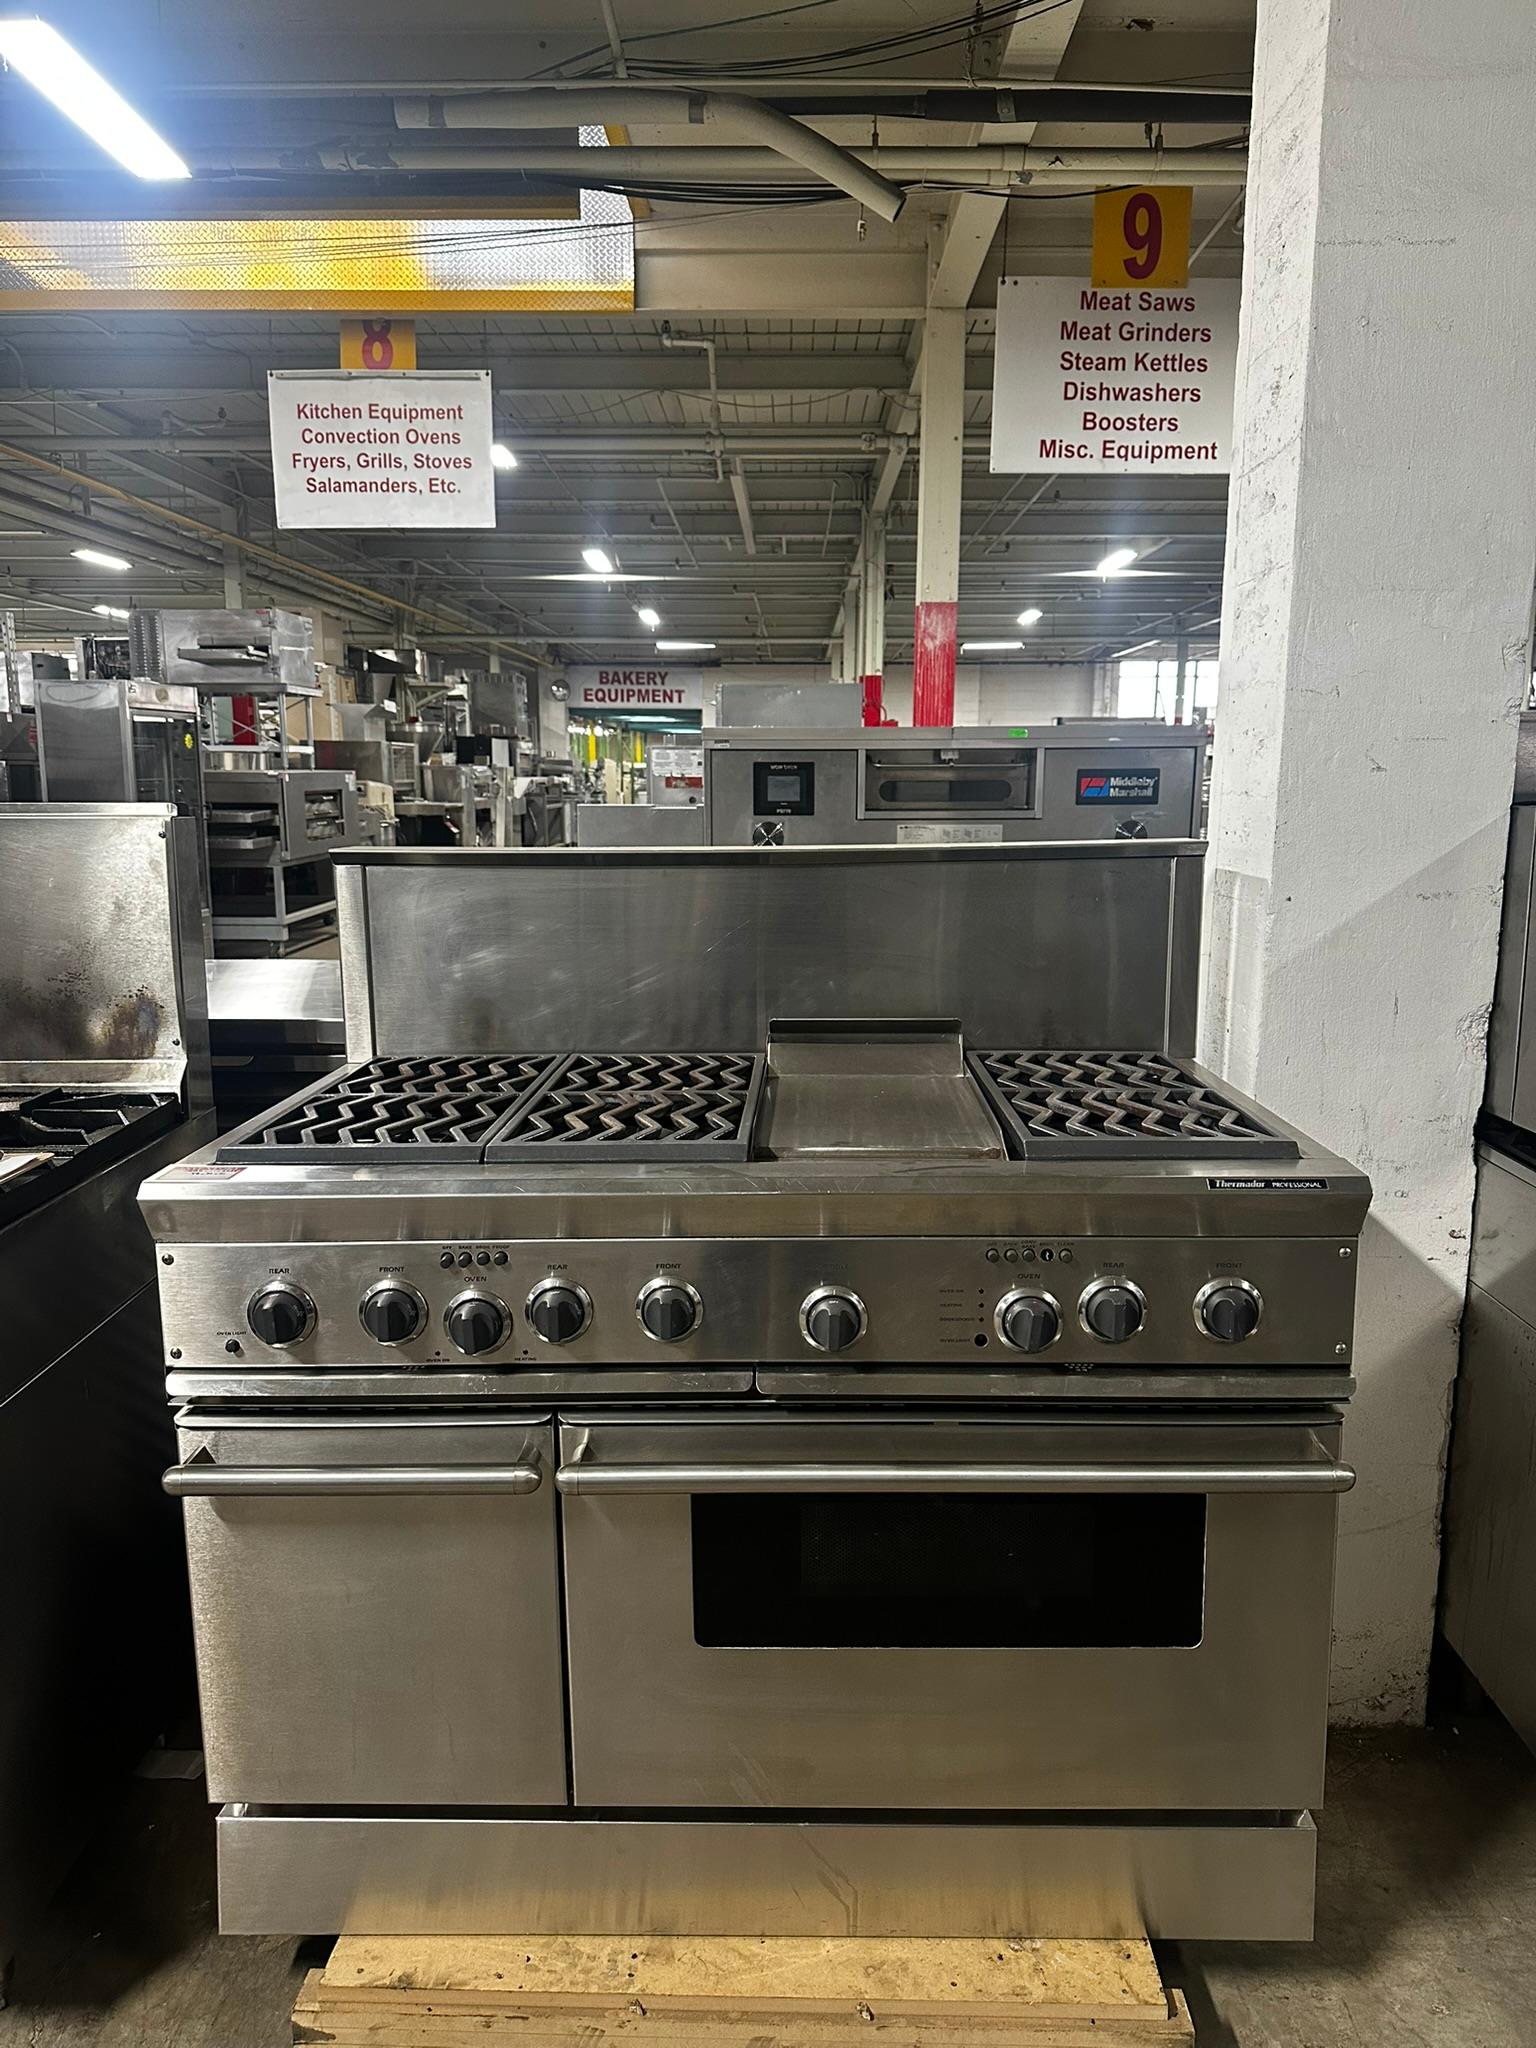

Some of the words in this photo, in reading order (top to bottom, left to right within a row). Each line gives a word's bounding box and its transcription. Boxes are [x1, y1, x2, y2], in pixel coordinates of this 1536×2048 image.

[1123, 192, 1163, 280] 9
[1080, 291, 1132, 312] Meat
[1138, 291, 1196, 312] Saws
[1060, 321, 1112, 342] Meat
[1118, 321, 1212, 342] Grinders
[362, 319, 394, 370] 8
[1060, 351, 1126, 372] Steam
[1134, 352, 1208, 372] Kettles
[1063, 381, 1201, 402] Dishwashers
[297, 403, 363, 420] Kitchen
[368, 403, 464, 423] Equipment
[1082, 411, 1179, 432] Boosters
[301, 428, 400, 445] Convection
[405, 428, 462, 445] Ovens
[1039, 439, 1094, 459] Misc.
[1102, 440, 1218, 464] Equipment
[292, 453, 351, 472] Fryers,
[356, 453, 408, 472] Grills,
[413, 453, 473, 469] Stoves
[306, 477, 423, 495] Salamanders,
[428, 478, 461, 494] Etc.
[599, 671, 669, 686] BAKERY
[583, 688, 686, 704] EQUIPMENT
[1110, 777, 1156, 787] Middleby
[1109, 788, 1153, 797] Marshall
[1215, 1179, 1266, 1188] Thermador
